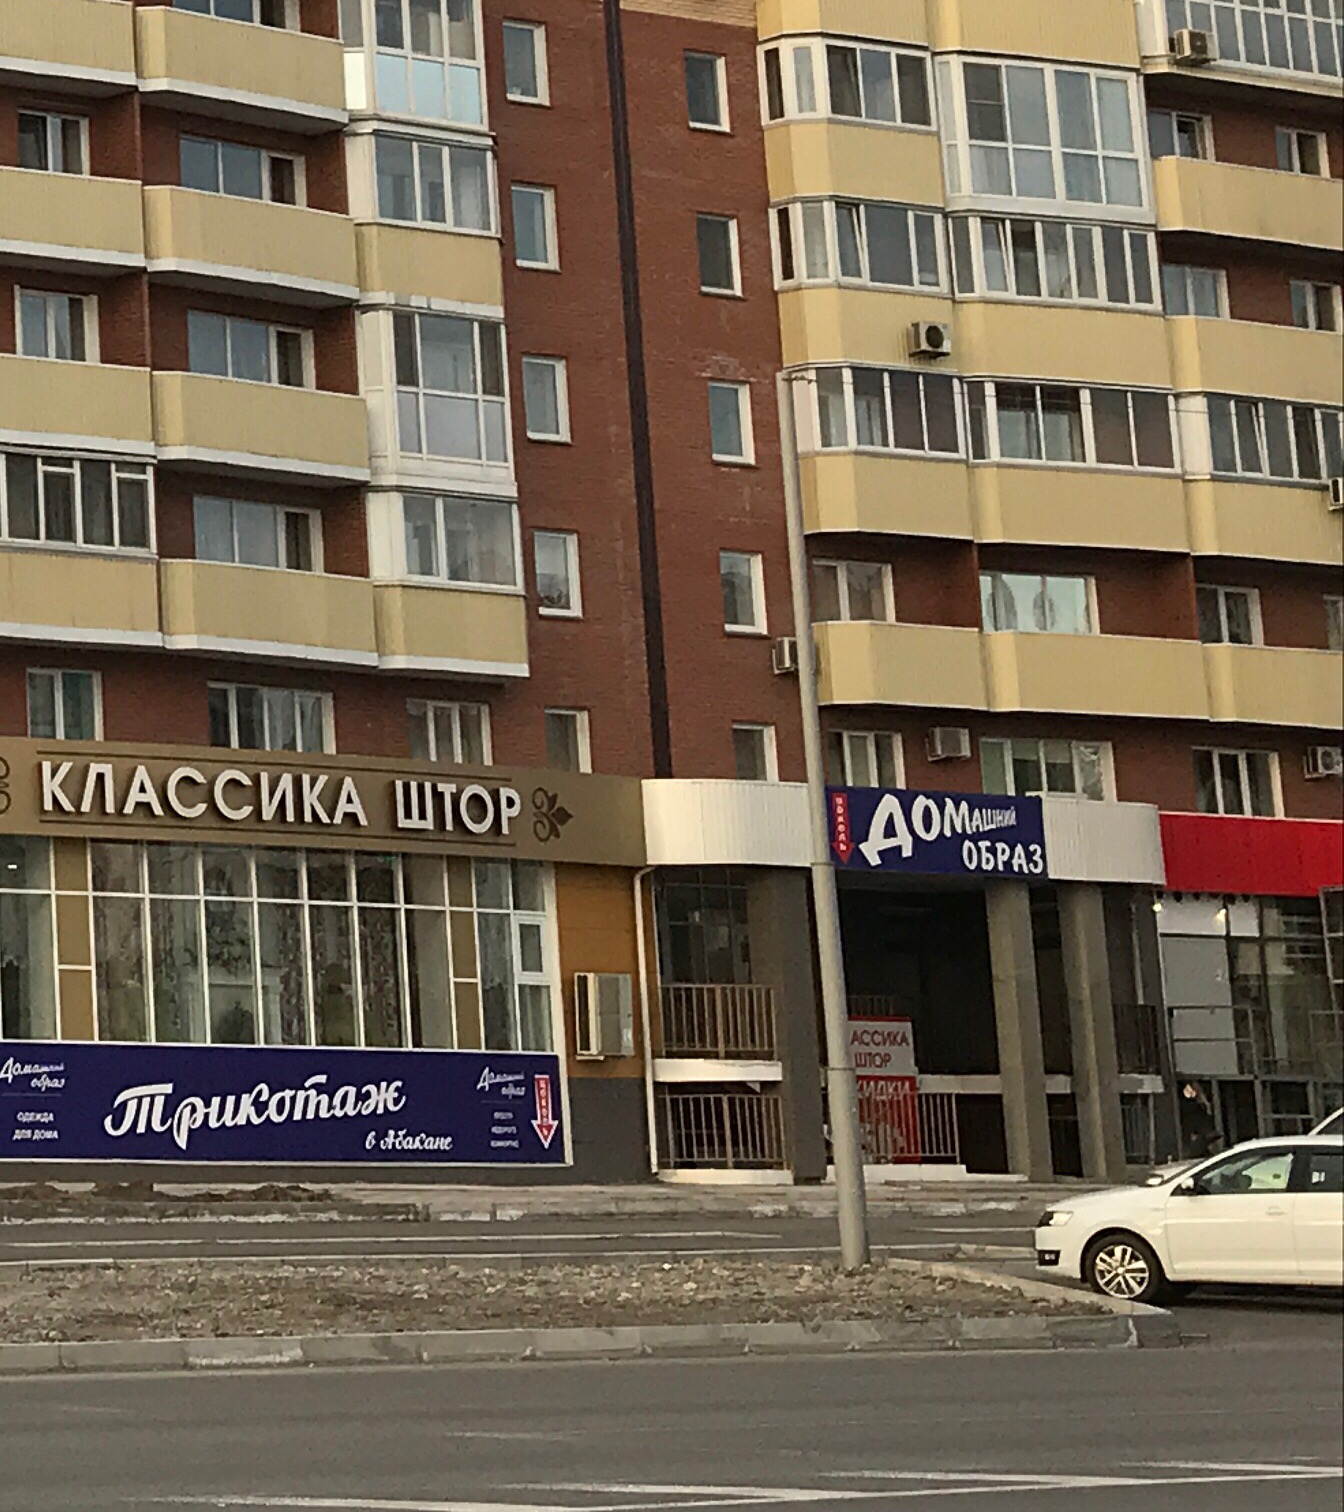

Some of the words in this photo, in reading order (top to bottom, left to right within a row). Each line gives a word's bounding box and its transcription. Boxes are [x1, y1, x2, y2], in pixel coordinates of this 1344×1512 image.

[40, 761, 369, 828] КЛАССИКА
[394, 779, 522, 836] ШТОР
[962, 839, 1044, 875] ОБРАЗ
[854, 1052, 892, 1069] ШТОР
[16, 1111, 54, 1124] ОДЕЖДА
[104, 1074, 407, 1151] Трикотаж
[12, 1129, 32, 1141] ДЛЯ
[32, 1129, 59, 1141] ДОМА
[365, 1130, 376, 1150] в
[380, 1129, 454, 1151] Абакане
